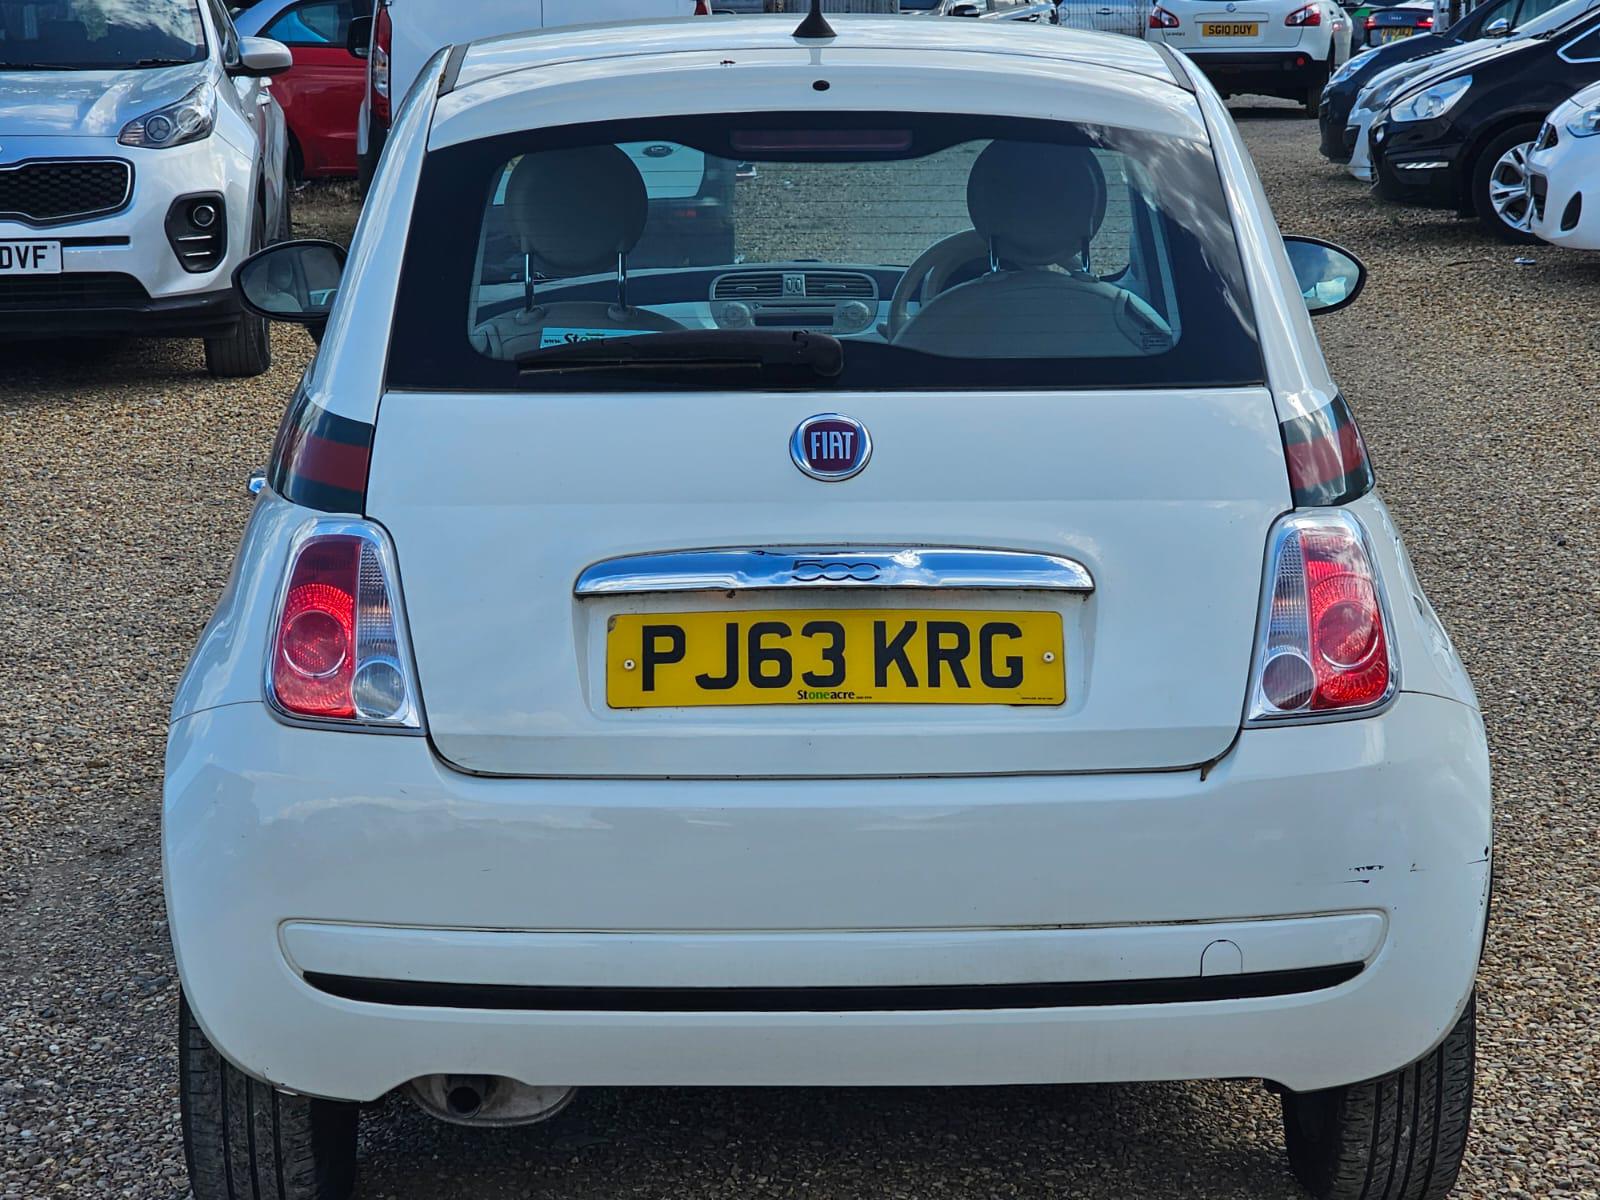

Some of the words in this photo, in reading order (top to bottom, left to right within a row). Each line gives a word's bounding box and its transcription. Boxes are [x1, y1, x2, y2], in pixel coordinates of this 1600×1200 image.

[1233, 25, 1252, 35] DUY
[0, 246, 48, 269] DVF
[811, 431, 854, 460] FIAT
[792, 559, 881, 582] 500
[641, 621, 846, 691] PJ63
[873, 620, 1024, 689] KRG
[797, 689, 855, 700] Stoneacre
